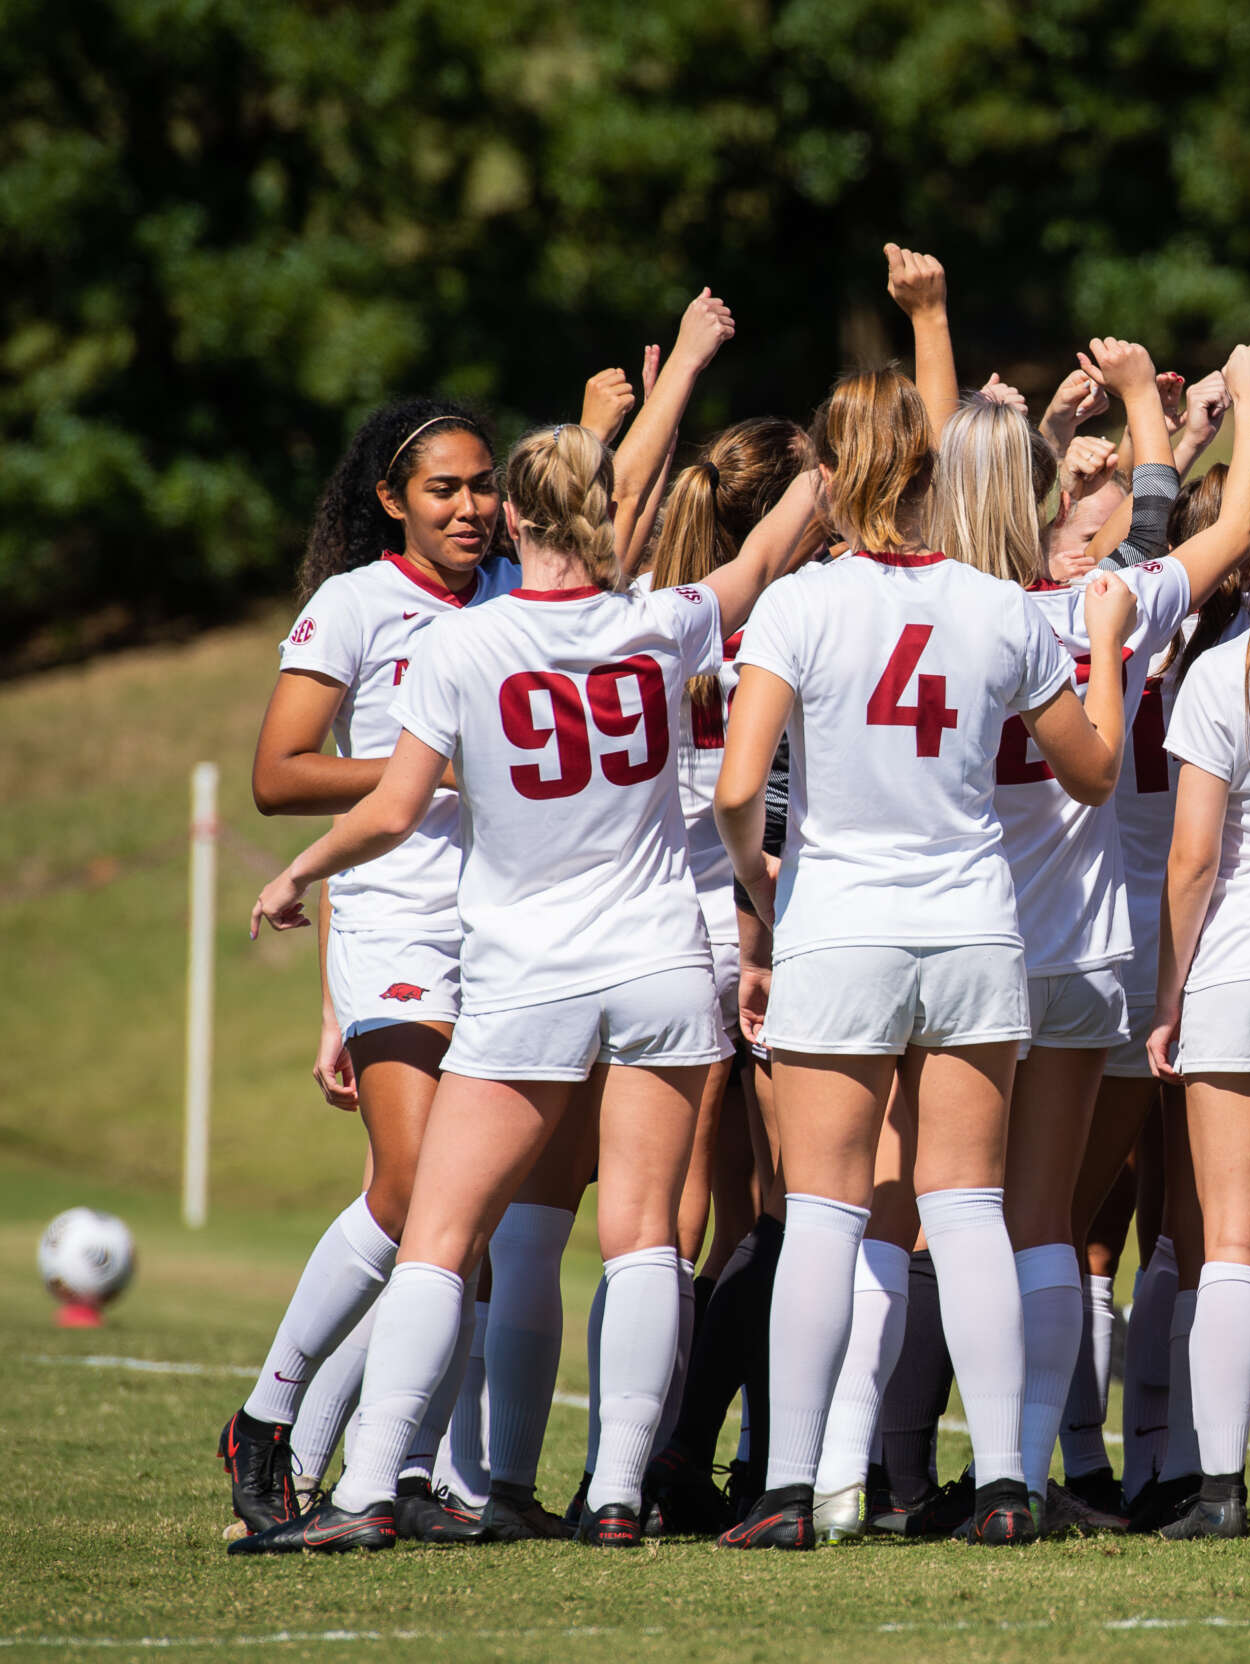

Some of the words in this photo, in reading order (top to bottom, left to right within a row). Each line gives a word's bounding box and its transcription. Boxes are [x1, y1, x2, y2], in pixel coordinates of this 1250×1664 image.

[291, 619, 314, 643] SEC
[866, 623, 958, 758] 4
[499, 654, 670, 801] 99
